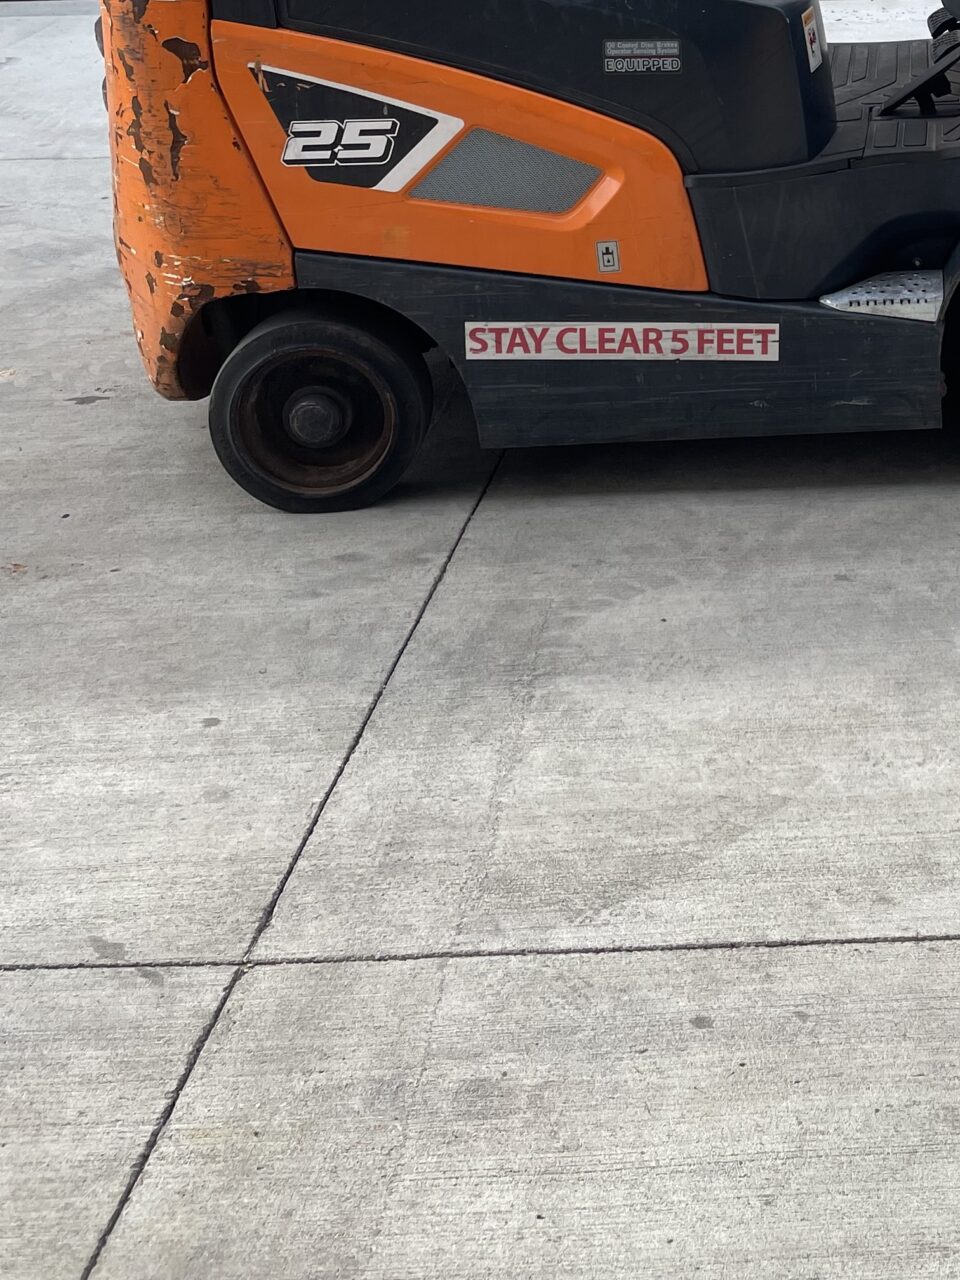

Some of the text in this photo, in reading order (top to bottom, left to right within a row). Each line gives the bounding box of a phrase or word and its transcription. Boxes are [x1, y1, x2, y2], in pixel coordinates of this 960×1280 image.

[604, 58, 681, 72] EQUIPPED
[280, 118, 400, 167] 25
[468, 327, 776, 355] STAY CLEAR 5 FEET
